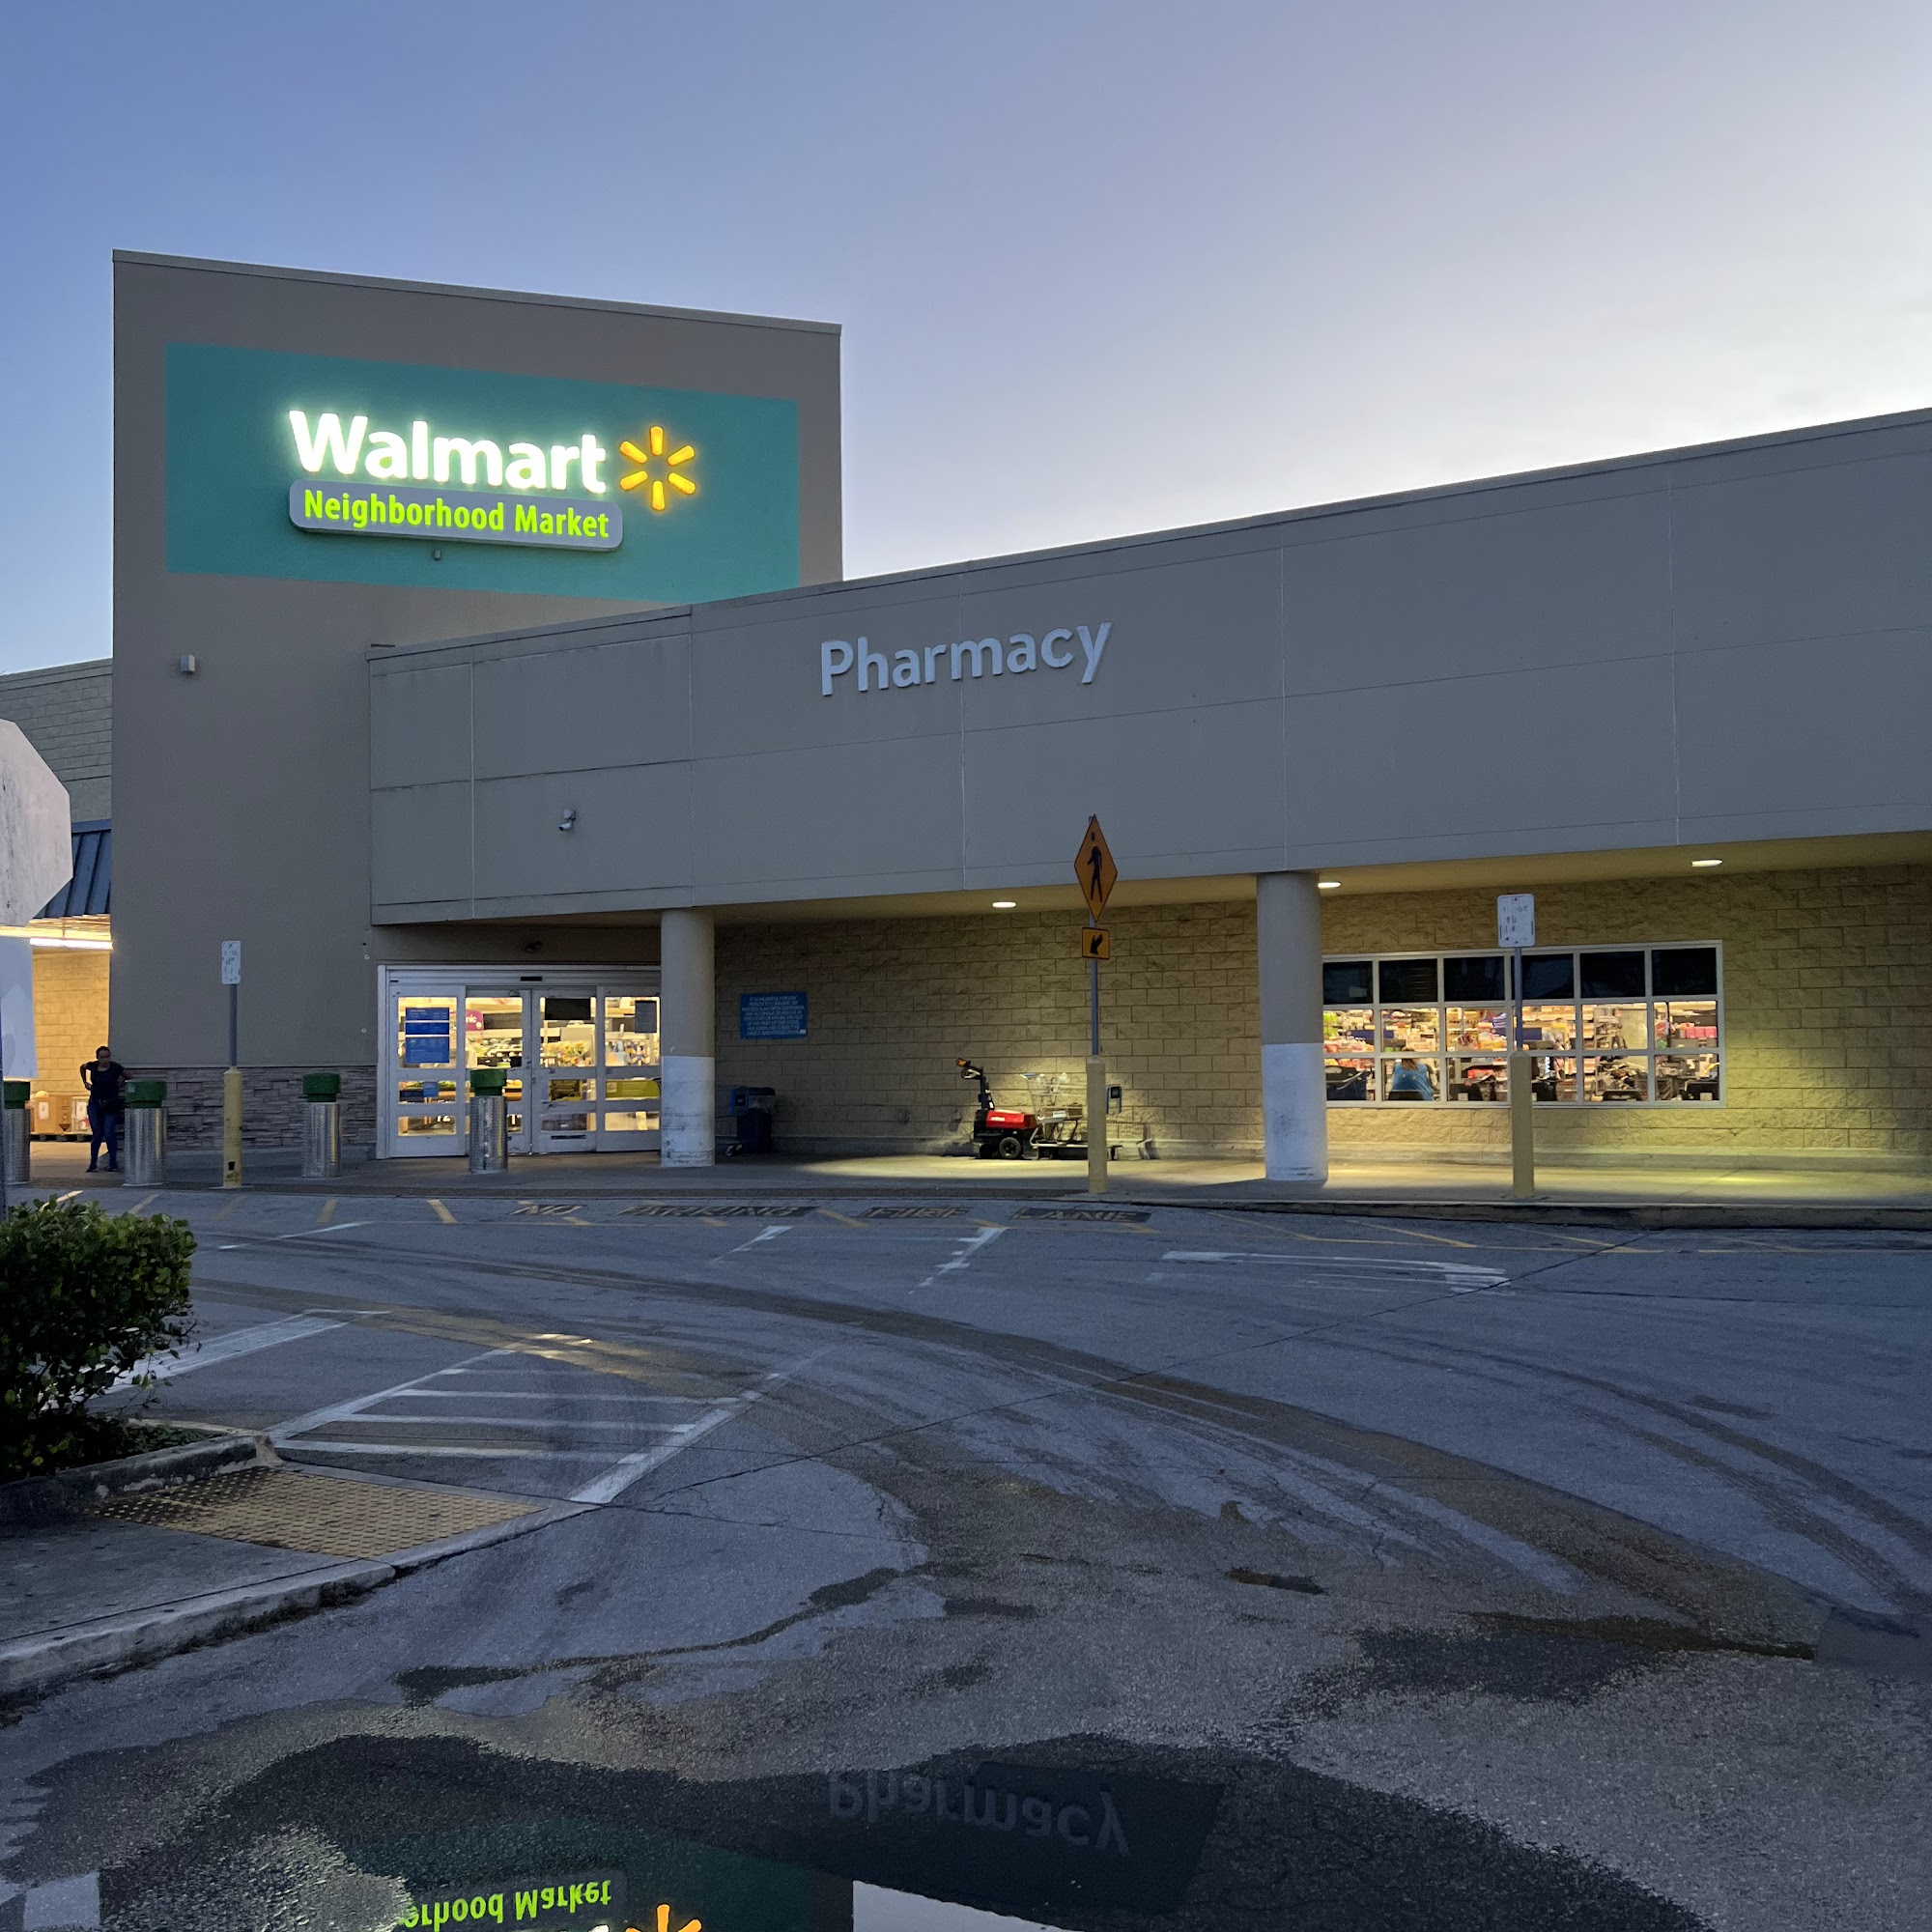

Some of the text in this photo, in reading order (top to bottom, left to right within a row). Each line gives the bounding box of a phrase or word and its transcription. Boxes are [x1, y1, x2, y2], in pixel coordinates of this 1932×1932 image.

[289, 410, 607, 494] Walmart
[304, 489, 610, 538] Neighborhood Market
[821, 621, 1111, 696] Pharmacy
